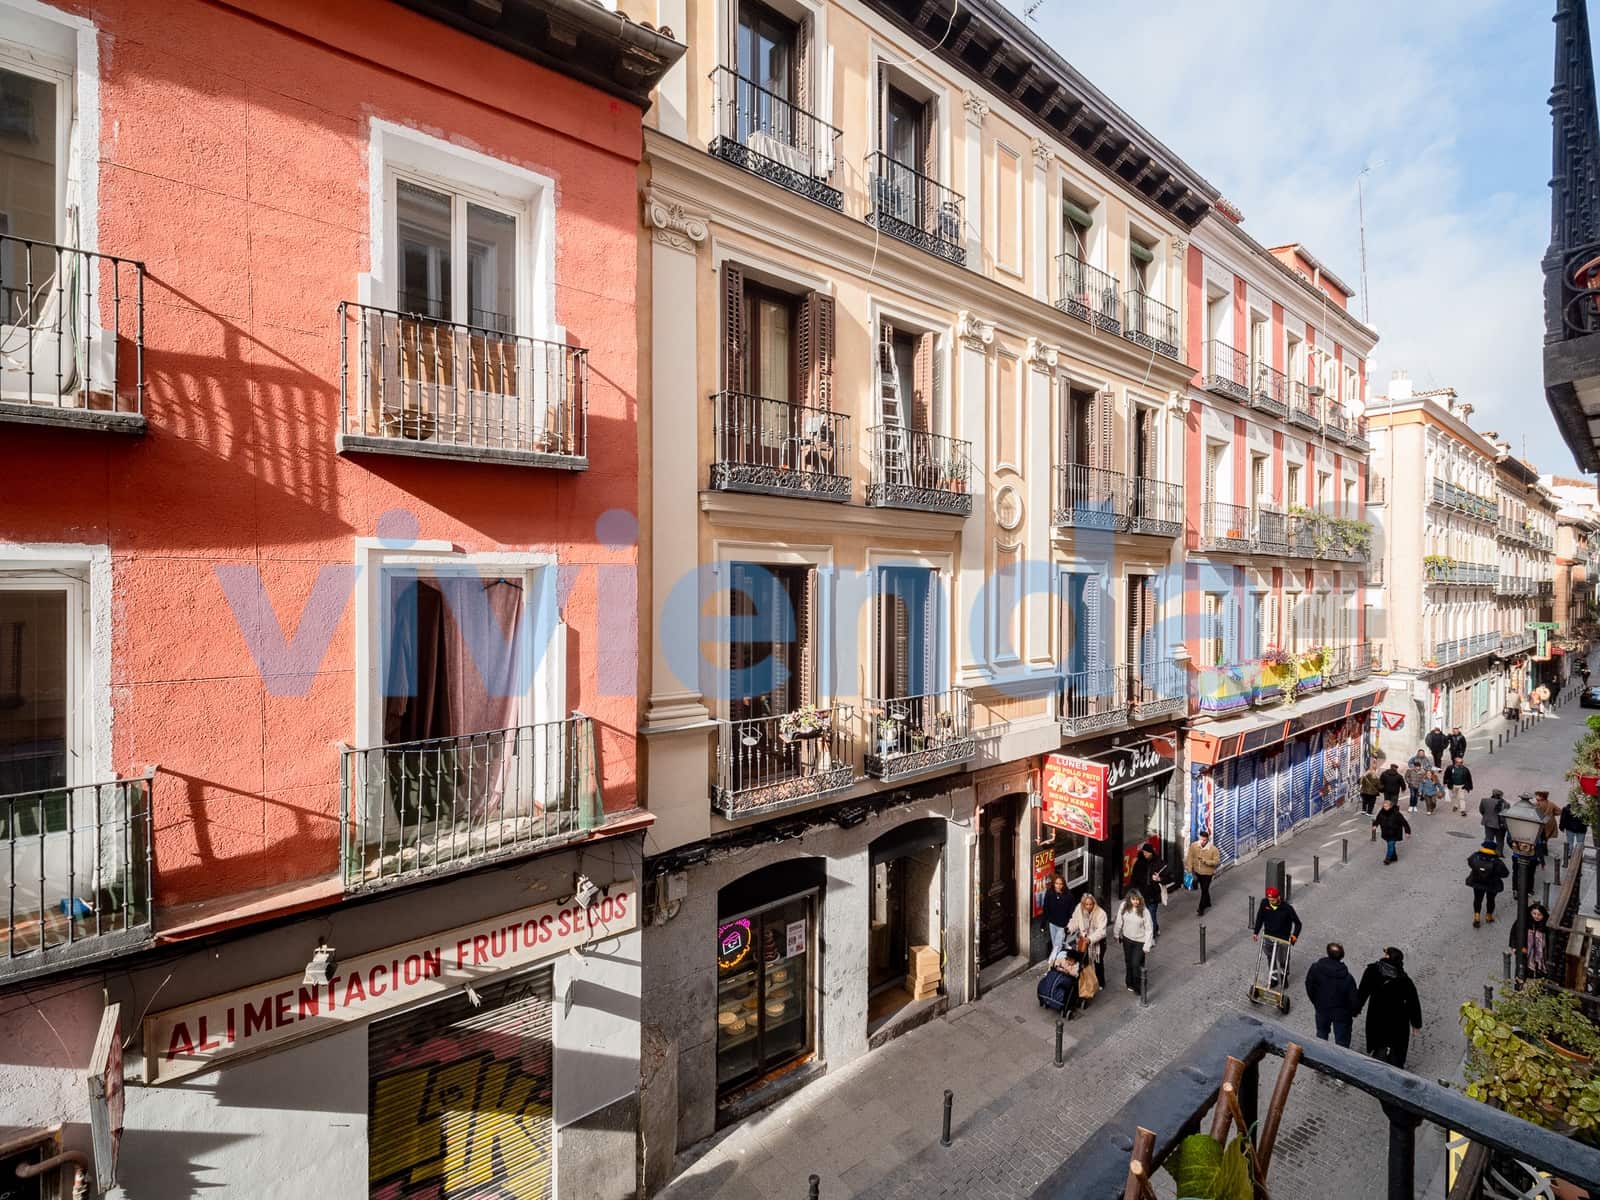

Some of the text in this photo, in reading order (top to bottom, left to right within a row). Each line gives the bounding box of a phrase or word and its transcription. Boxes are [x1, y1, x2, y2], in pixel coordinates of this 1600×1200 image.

[1056, 758, 1088, 771] LUNES
[1127, 744, 1161, 777] Pita
[166, 947, 441, 1062] ALIMENTACION
[456, 914, 554, 970] FRUTOS
[558, 892, 628, 937] SECOS
